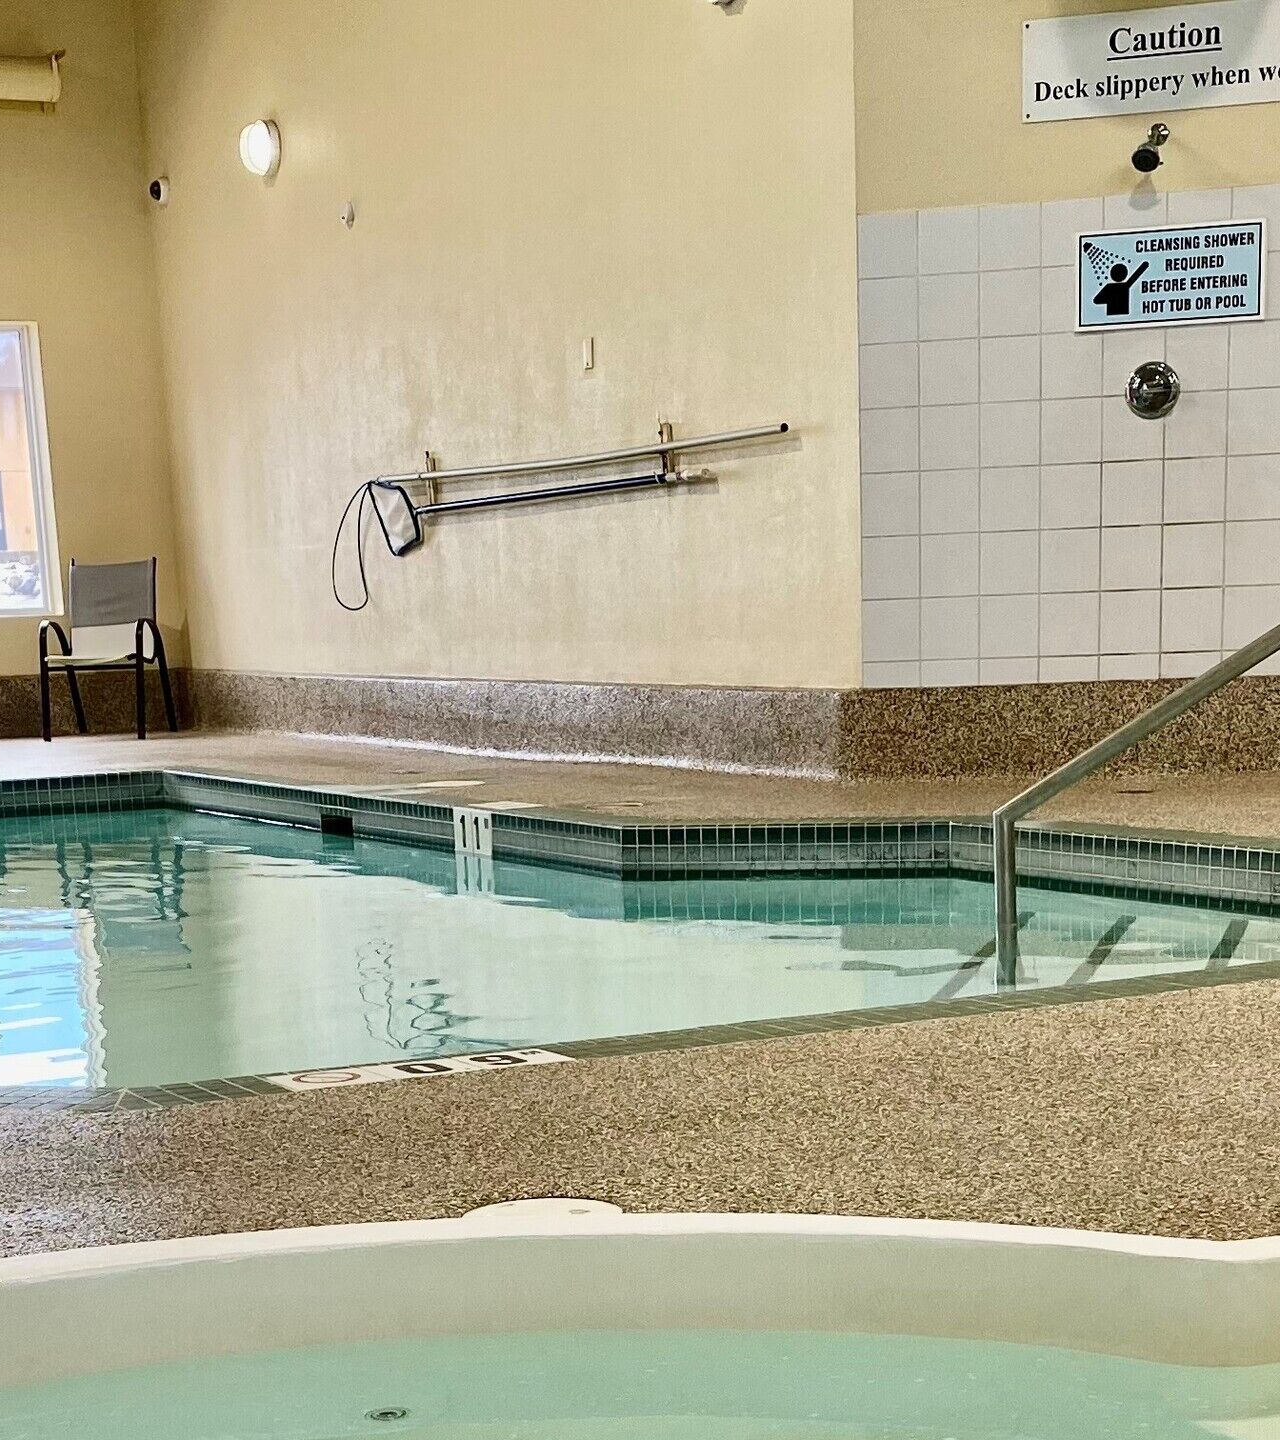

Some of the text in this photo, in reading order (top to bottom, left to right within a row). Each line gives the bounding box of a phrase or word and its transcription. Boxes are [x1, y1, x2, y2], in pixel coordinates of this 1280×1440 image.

[1109, 22, 1221, 54] Caution
[1034, 78, 1088, 102] Deck
[1095, 73, 1184, 100] slippery
[1192, 66, 1250, 88] when
[1135, 232, 1255, 252] CLEANSING SHOWER
[1165, 255, 1224, 271] REQUIRED
[1141, 274, 1247, 293] BEFORE ENTERING
[1143, 295, 1246, 314] HOT TUB OR POOL
